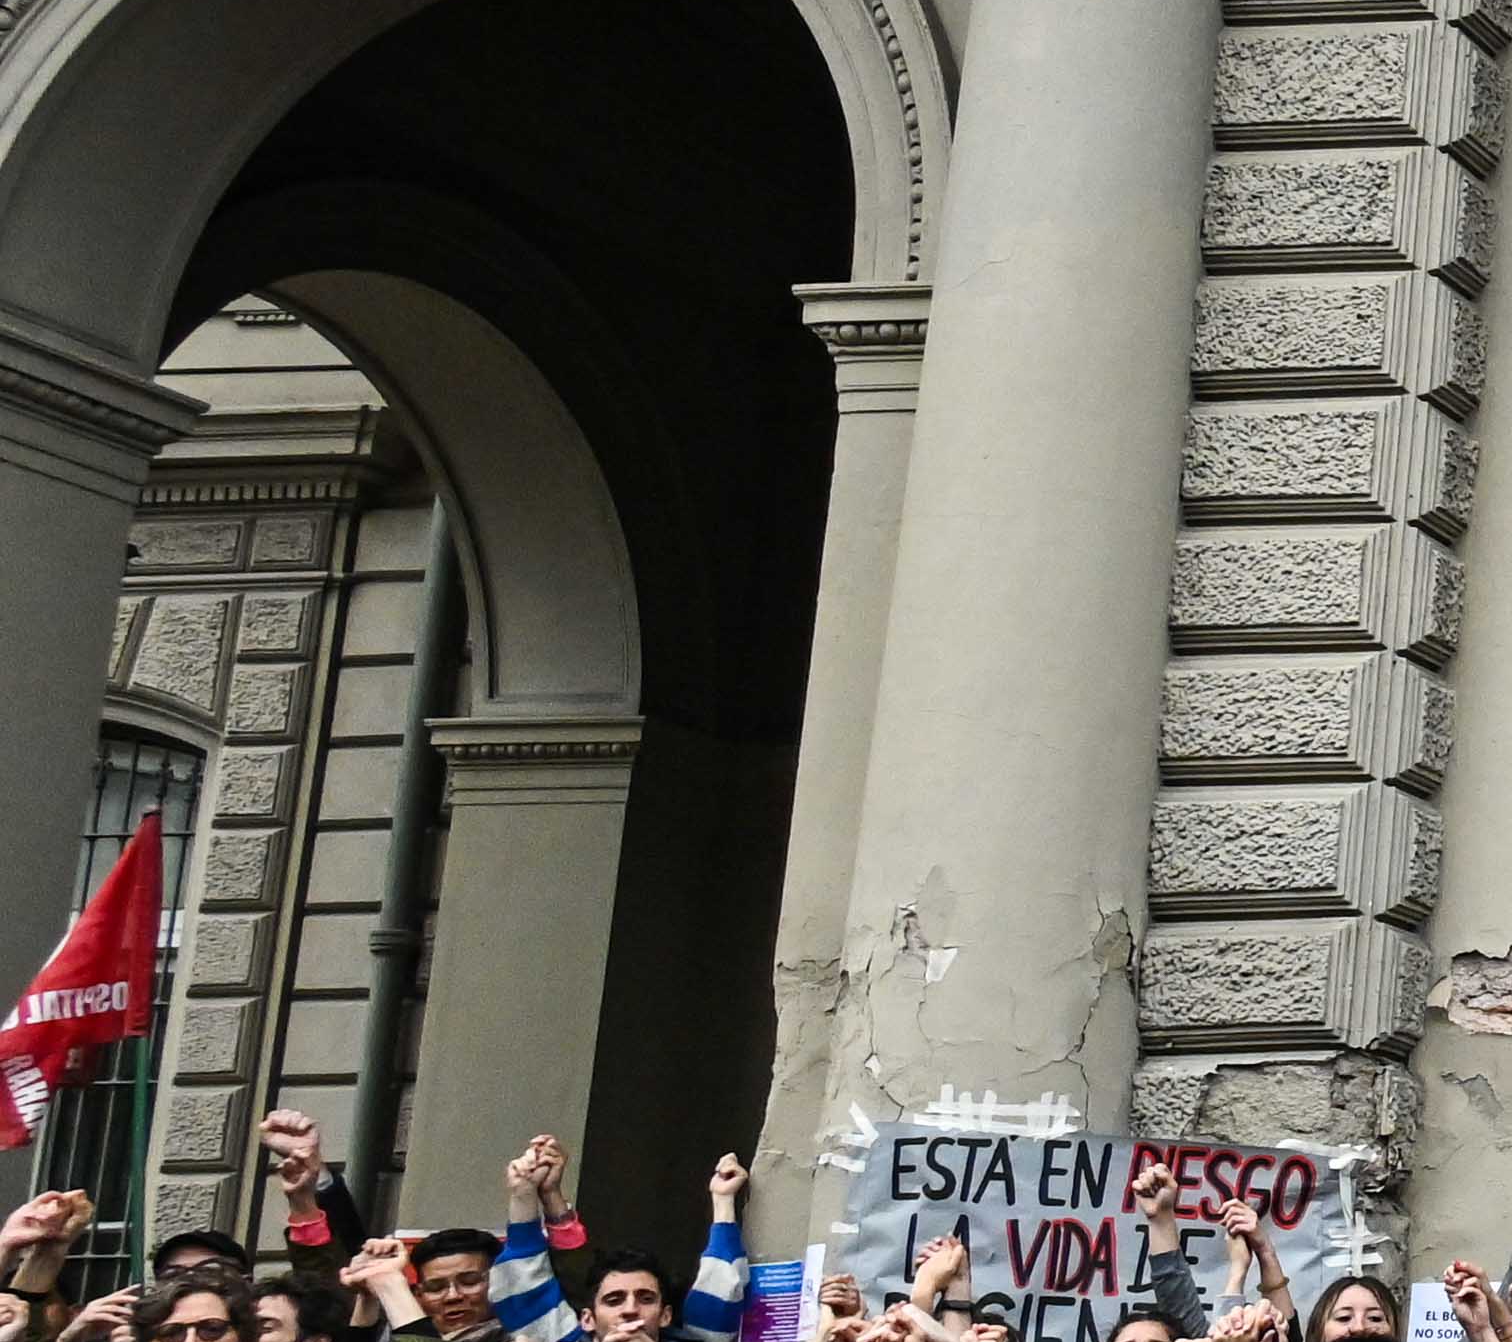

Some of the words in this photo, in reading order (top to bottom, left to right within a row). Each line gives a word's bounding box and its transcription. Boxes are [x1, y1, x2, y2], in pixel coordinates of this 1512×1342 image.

[891, 1132, 1018, 1207] ESTÁ
[1038, 1139, 1113, 1212] EN
[1006, 1217, 1119, 1296] VIDA
[1415, 1328, 1433, 1340] NO
[1437, 1329, 1465, 1340] SOM
[1425, 1310, 1439, 1322] EL
